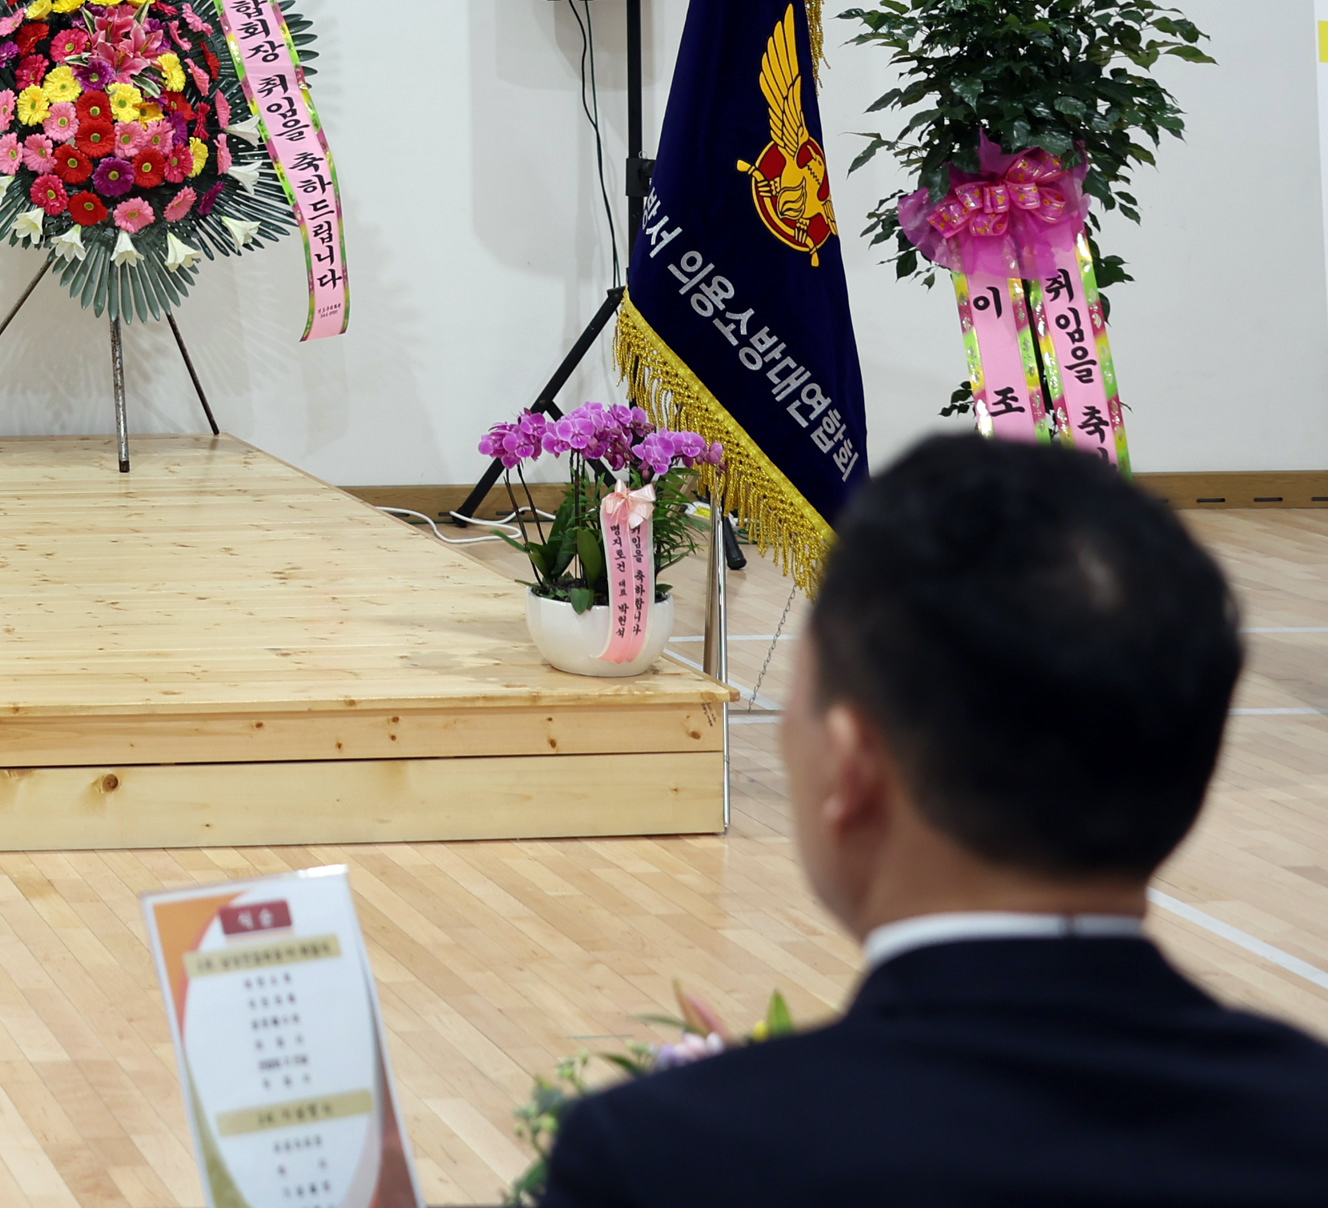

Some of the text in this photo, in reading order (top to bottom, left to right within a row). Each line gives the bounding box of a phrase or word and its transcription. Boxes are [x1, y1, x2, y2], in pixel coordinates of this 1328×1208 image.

[257, 73, 310, 143] 취임을
[289, 151, 343, 291] 축하드립니다
[642, 176, 859, 482] 방서 의용소방대연합회
[1045, 268, 1098, 384] 취임을
